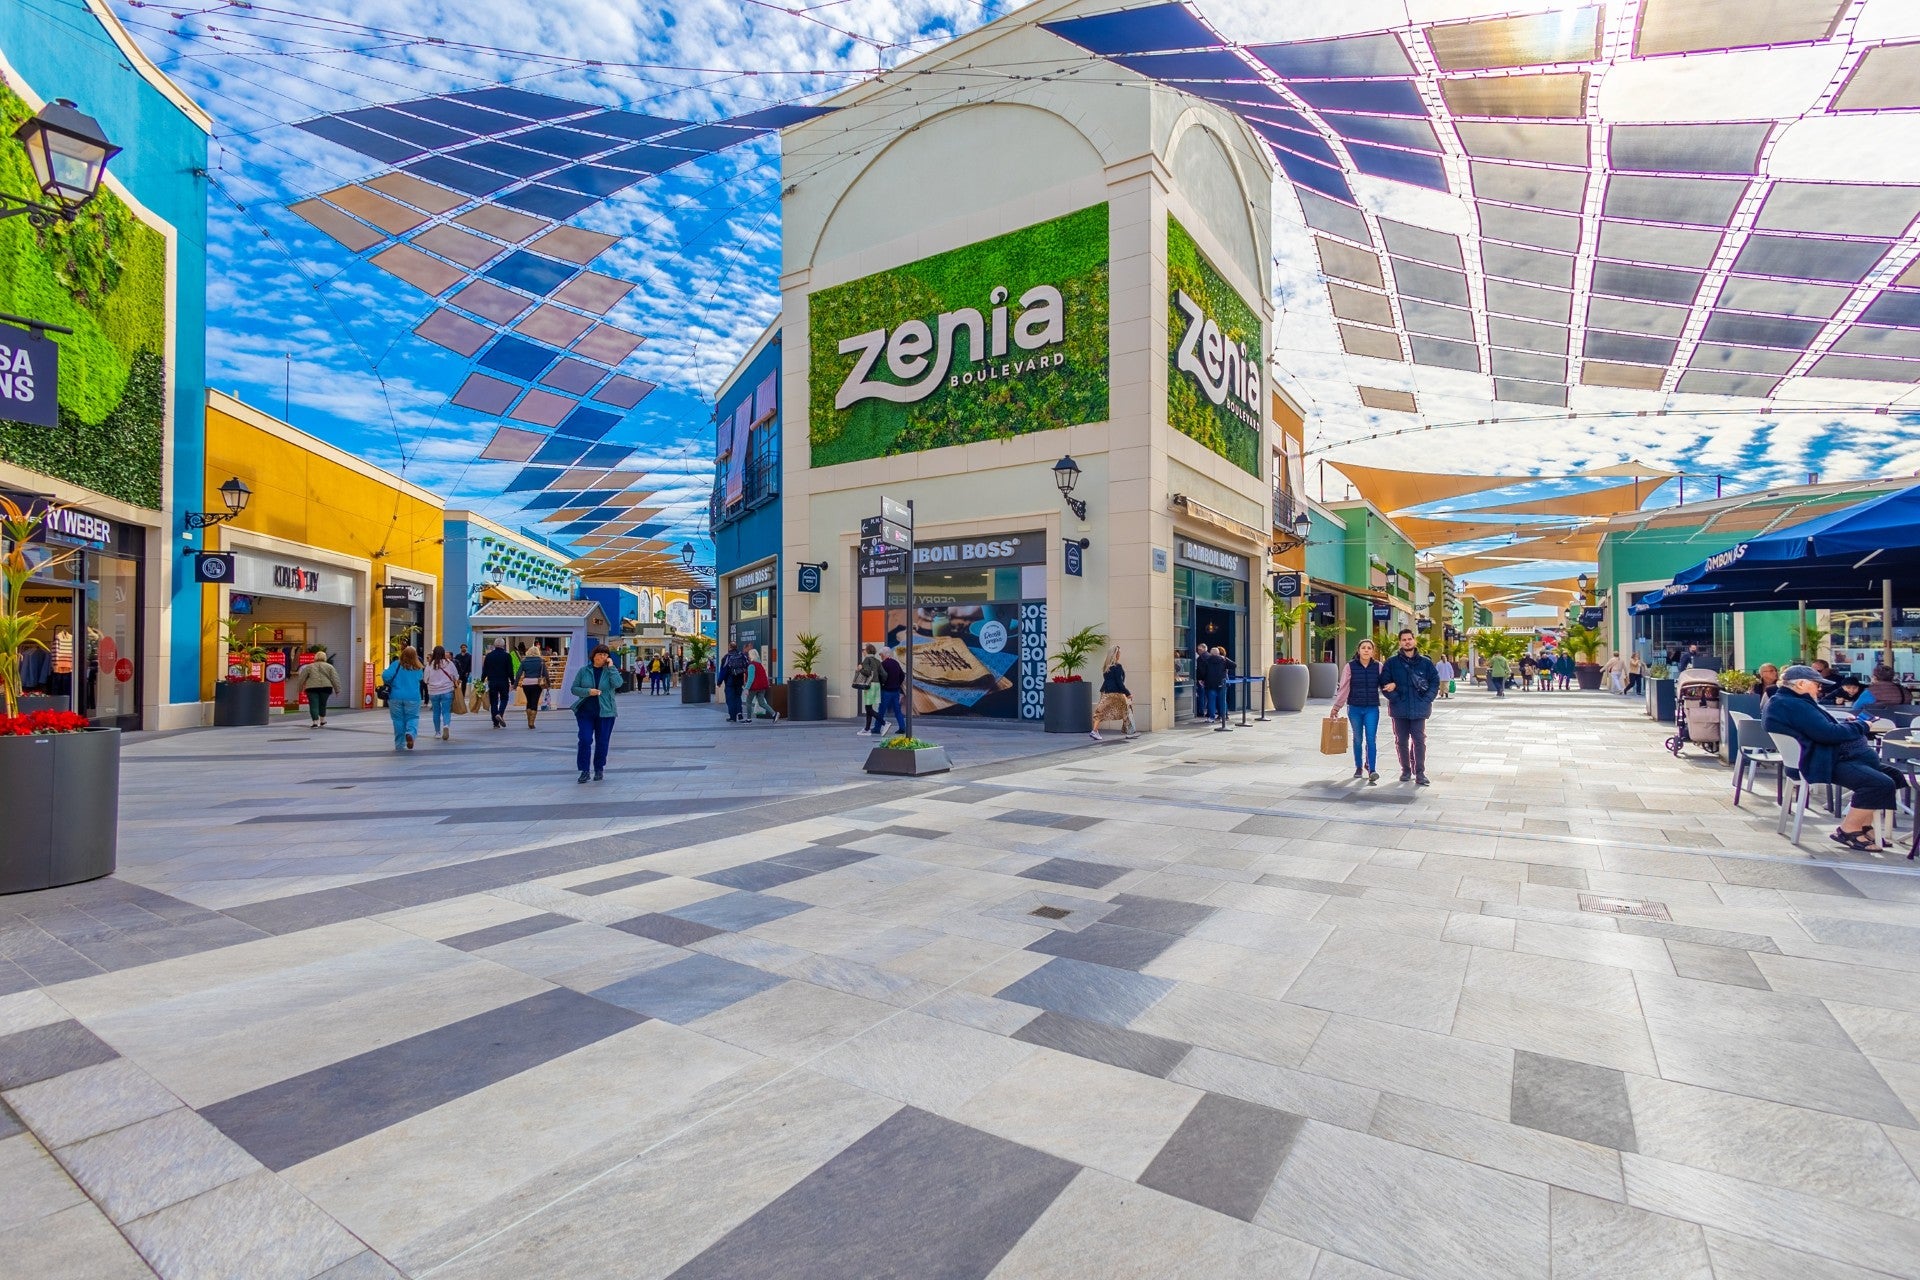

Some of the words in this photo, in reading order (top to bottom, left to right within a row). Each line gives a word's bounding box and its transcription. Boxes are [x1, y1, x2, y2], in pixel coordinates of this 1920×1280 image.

[950, 352, 1065, 388] BOULEVARD
[1226, 398, 1260, 432] BOULEVARD
[64, 509, 111, 544] WEBER
[1187, 542, 1219, 567] BOMBON
